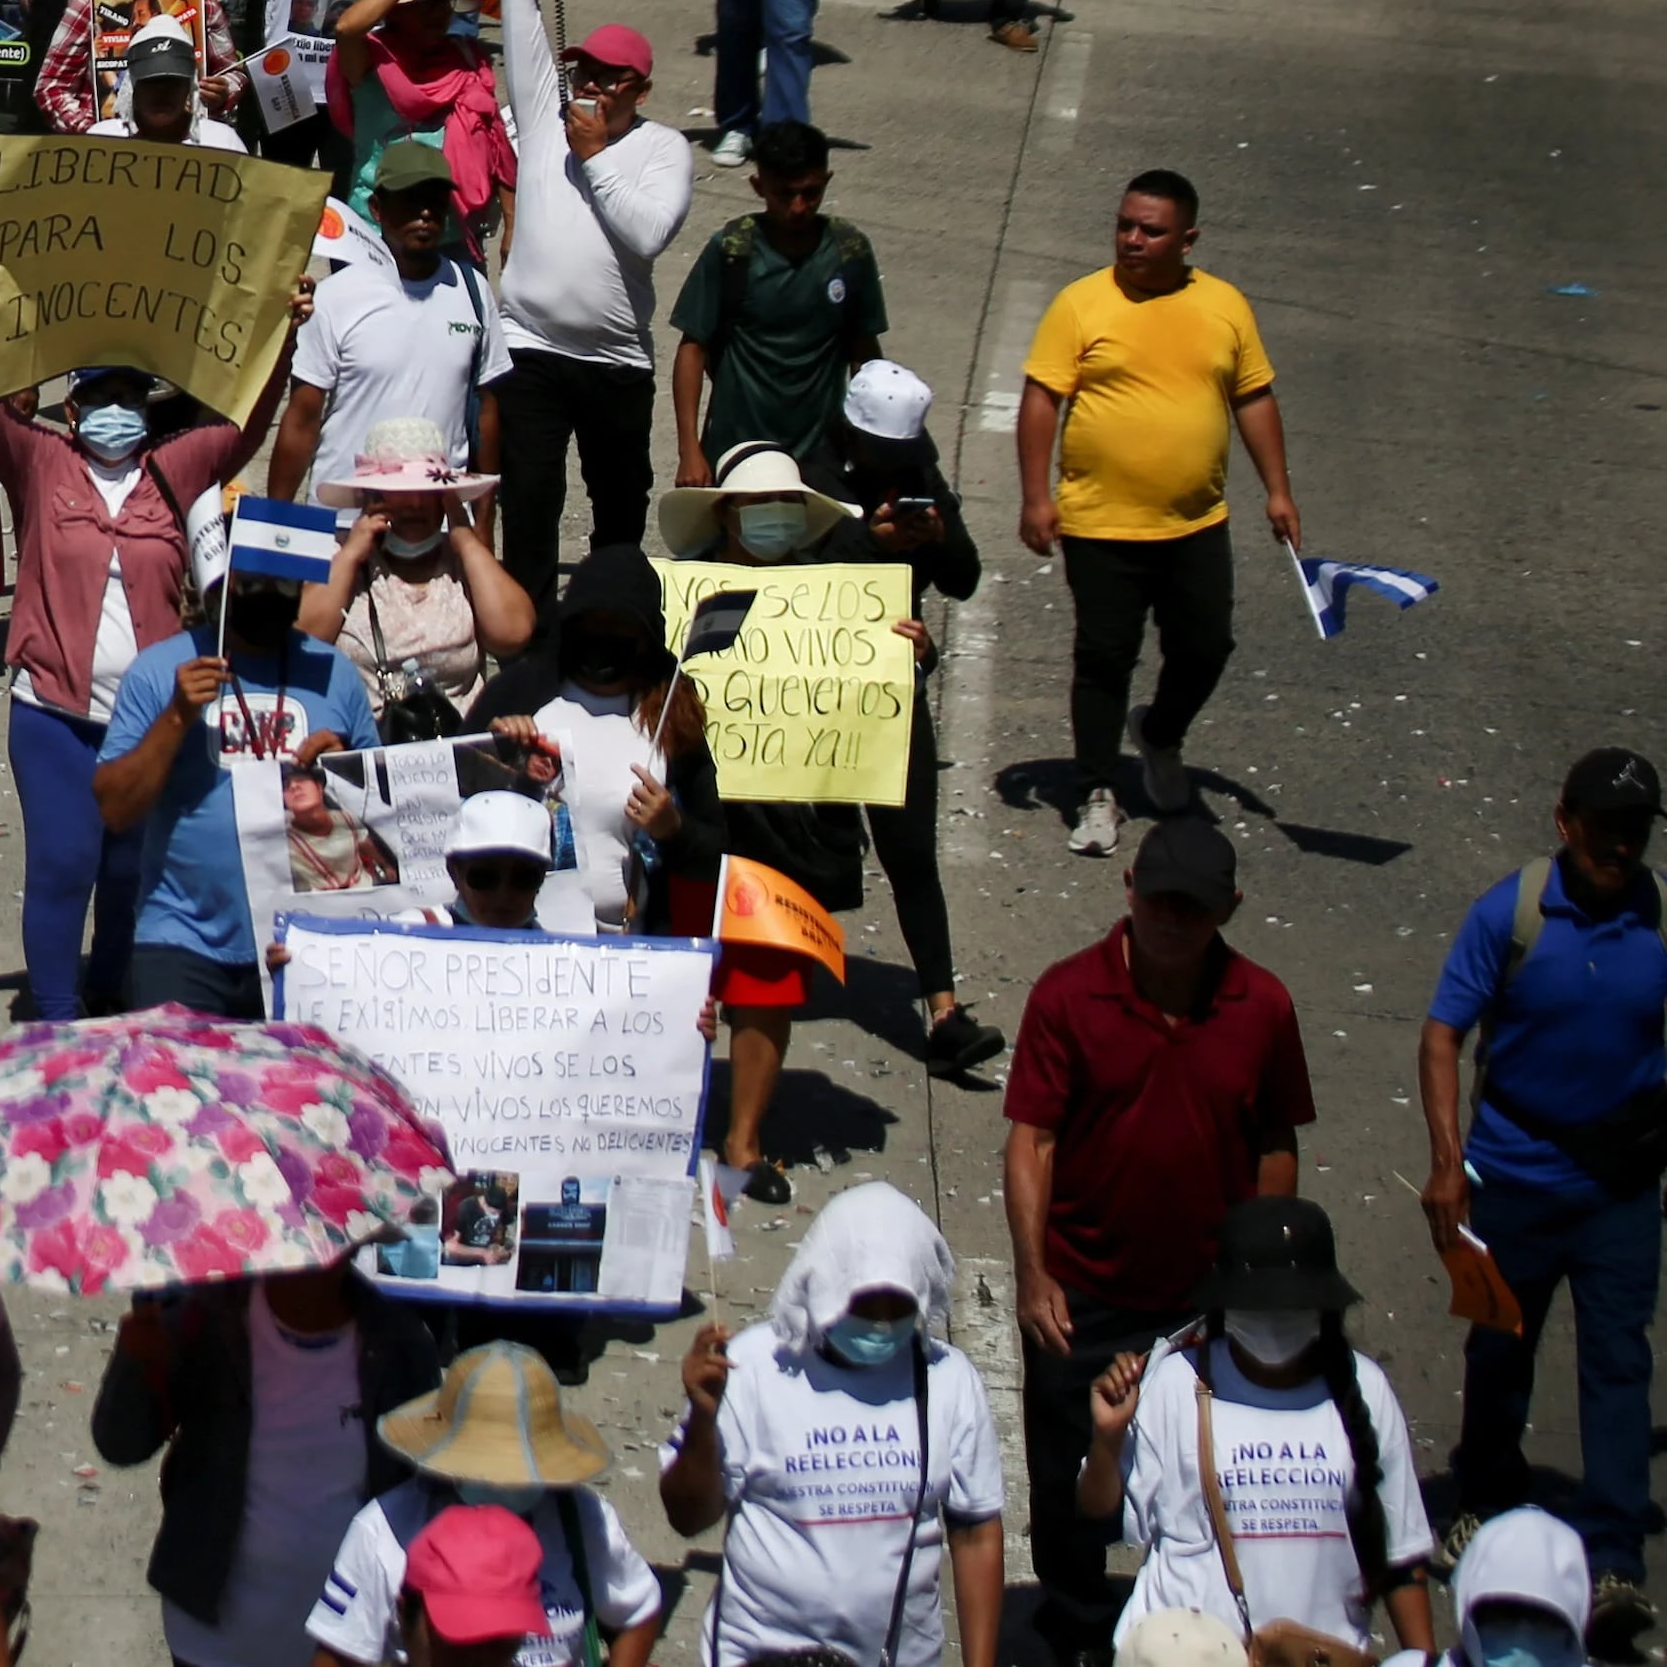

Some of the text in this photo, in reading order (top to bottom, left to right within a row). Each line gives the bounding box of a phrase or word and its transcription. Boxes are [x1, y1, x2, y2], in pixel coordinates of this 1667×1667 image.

[98, 5, 130, 26] TIRANO
[164, 222, 246, 286] LOS
[5, 281, 243, 369] INOCENTES.
[783, 627, 876, 667] VIVOS
[298, 940, 433, 991] SEÑOR
[589, 1013, 608, 1034] A
[621, 1010, 665, 1035] LOS
[555, 1050, 580, 1078] SE
[588, 1054, 636, 1078] LOS
[538, 1097, 572, 1119] LOS
[805, 1423, 900, 1450] ¡NO A LA
[785, 1444, 922, 1473] REELECCIÓN!
[1231, 1441, 1327, 1465] ¡NO A LA
[818, 1502, 835, 1516] SE
[1241, 1518, 1257, 1531] SE
